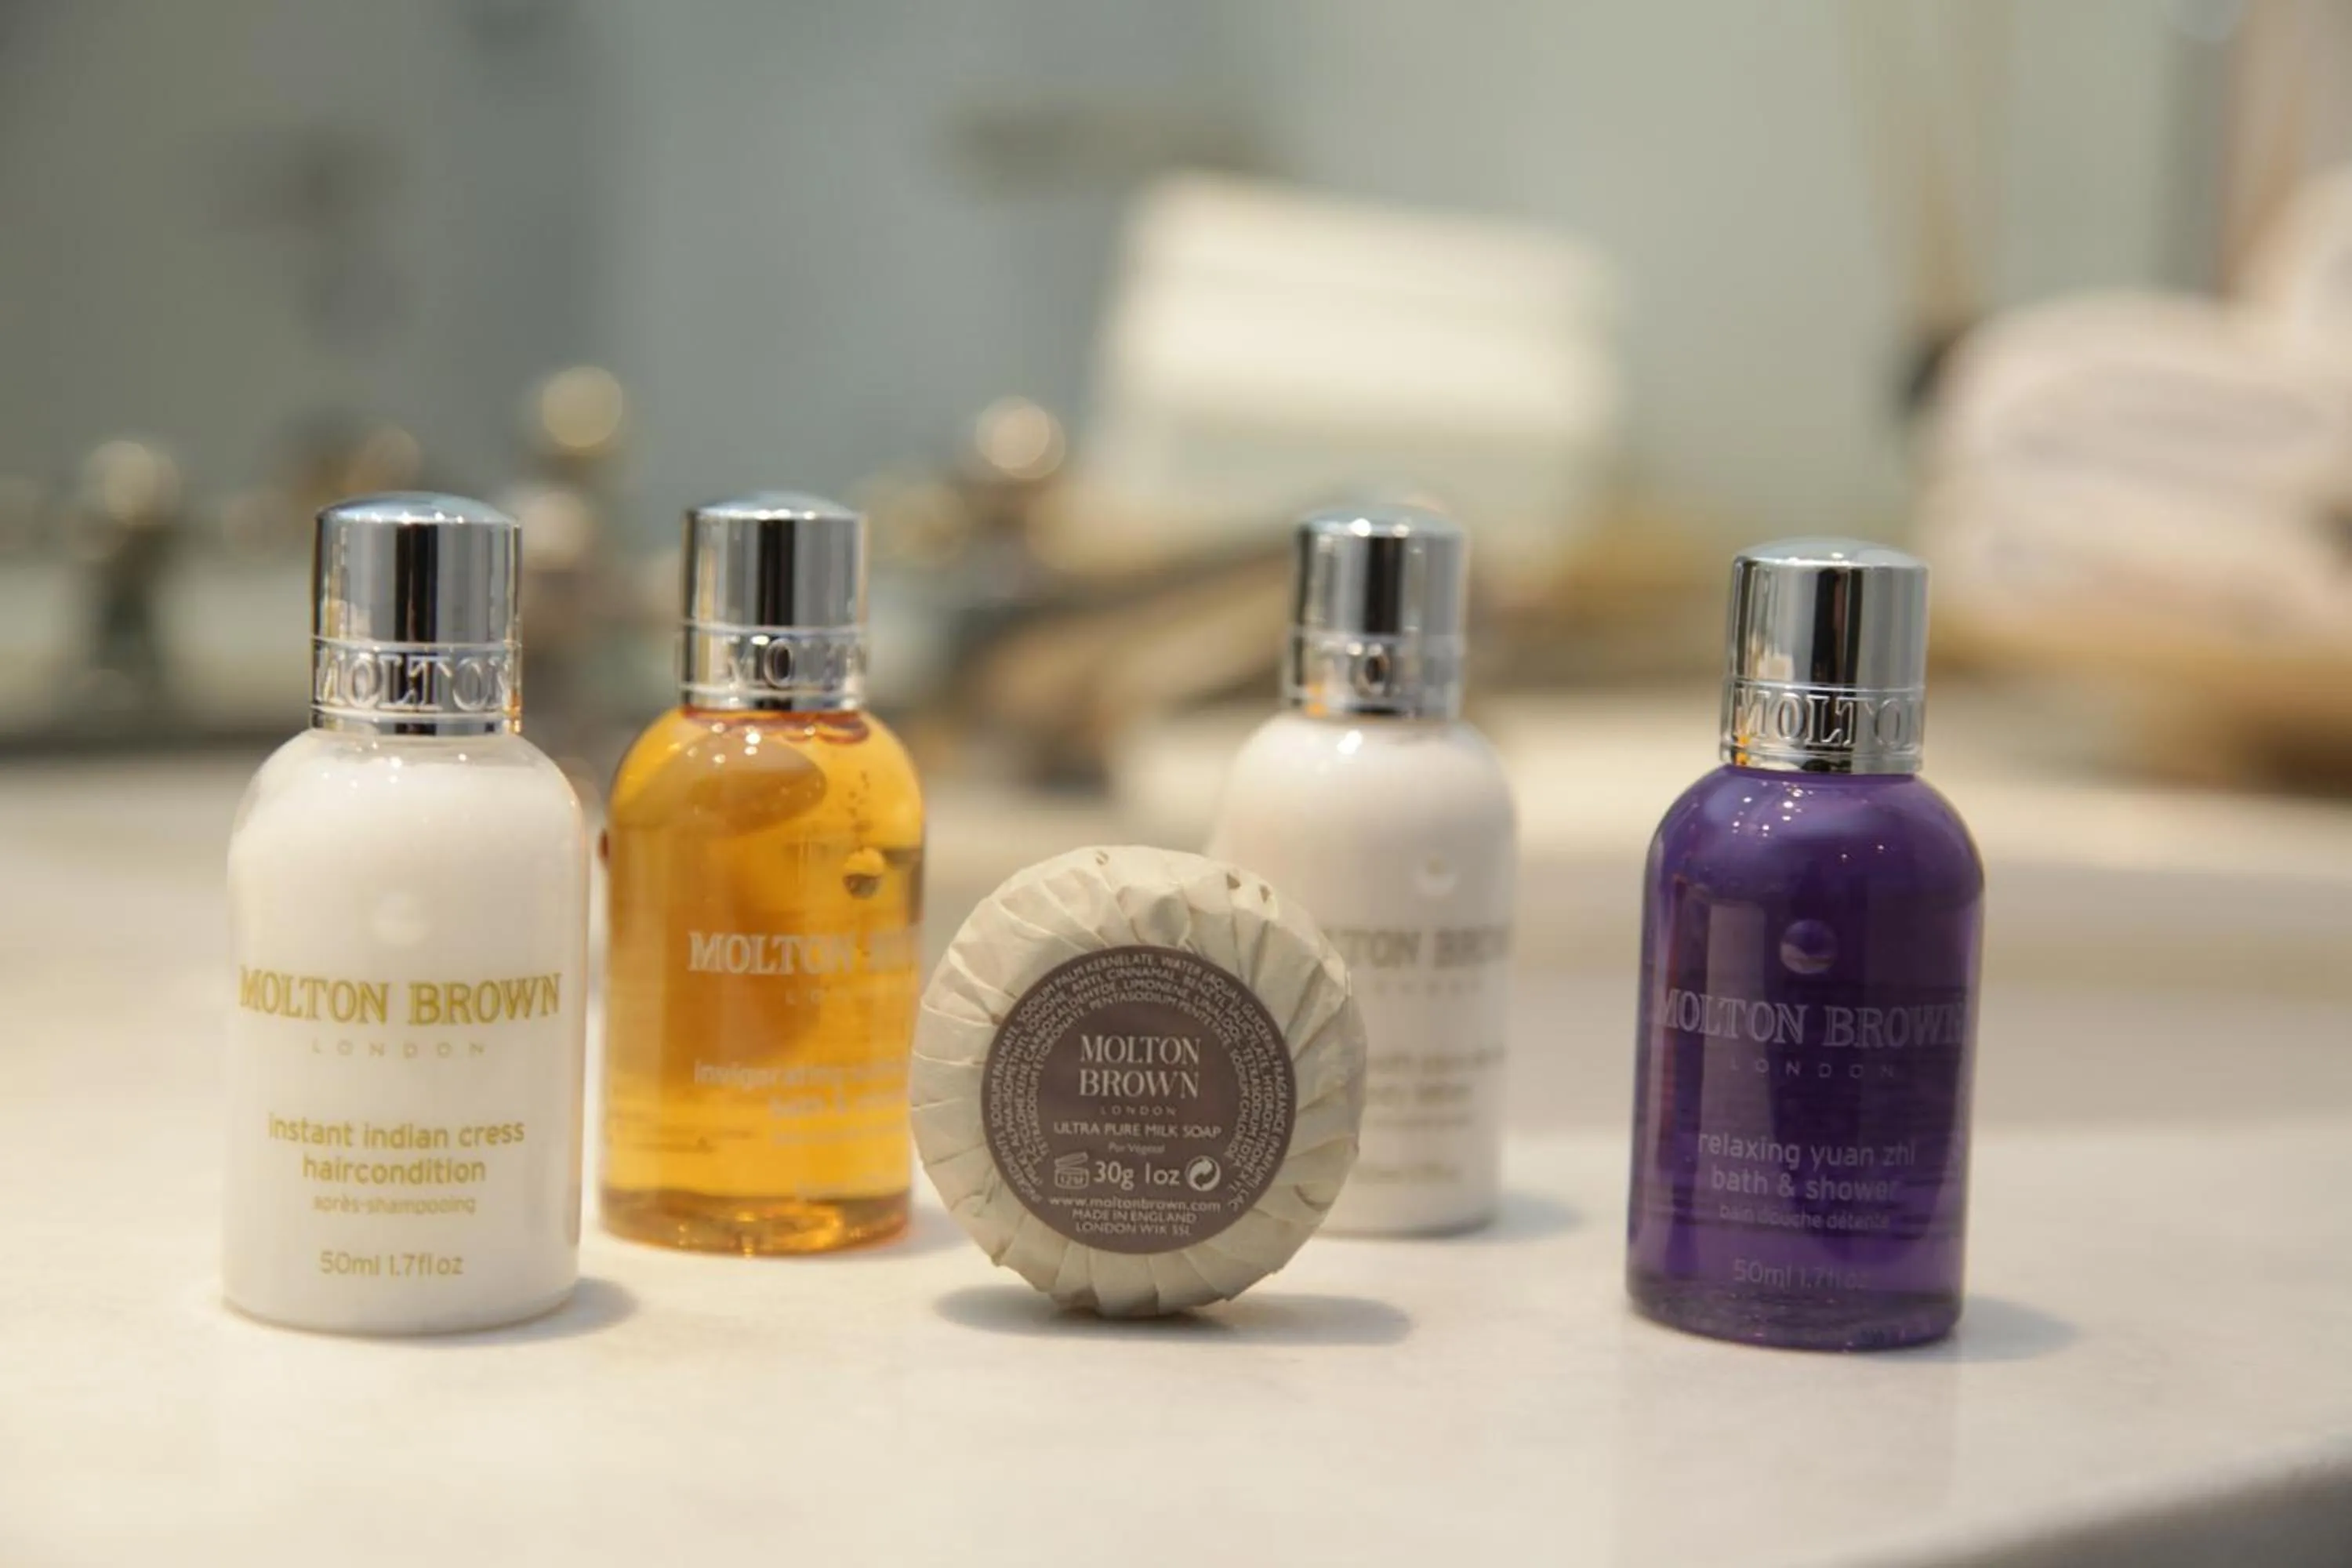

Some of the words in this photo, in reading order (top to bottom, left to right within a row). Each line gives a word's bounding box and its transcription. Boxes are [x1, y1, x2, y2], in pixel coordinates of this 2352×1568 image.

[240, 965, 390, 1025] MOLTON
[408, 971, 562, 1026] BROWN
[313, 1038, 485, 1058] LONDON
[1080, 1035, 1201, 1065] MOLTON
[1729, 1057, 1895, 1079] LONDON
[1079, 1069, 1200, 1099] BROWN
[1101, 1105, 1178, 1116] LONDON
[268, 1112, 354, 1147] instant
[363, 1121, 448, 1149] indian
[458, 1121, 525, 1147] cress
[1054, 1121, 1101, 1135] ULTRA
[1104, 1122, 1141, 1136] PURE
[1145, 1123, 1178, 1138] MILK
[1182, 1125, 1222, 1138] SOAP
[1698, 1132, 1801, 1171] relaxing
[1809, 1145, 1875, 1172] yuan
[1882, 1138, 1916, 1167] zhi
[303, 1152, 486, 1185] haircondition
[1093, 1160, 1134, 1191] 30g
[1710, 1163, 1769, 1195] bath
[1775, 1173, 1795, 1198] &
[1806, 1174, 1899, 1201] shower
[1049, 1196, 1221, 1213] www.moltonbrown.com
[1072, 1208, 1109, 1221] MADE
[1113, 1210, 1127, 1221] IN
[1130, 1210, 1198, 1225] ENGLAND
[1075, 1221, 1137, 1236] LONDON
[320, 1250, 380, 1276] 50ml
[1732, 1255, 1792, 1292] 50ml
